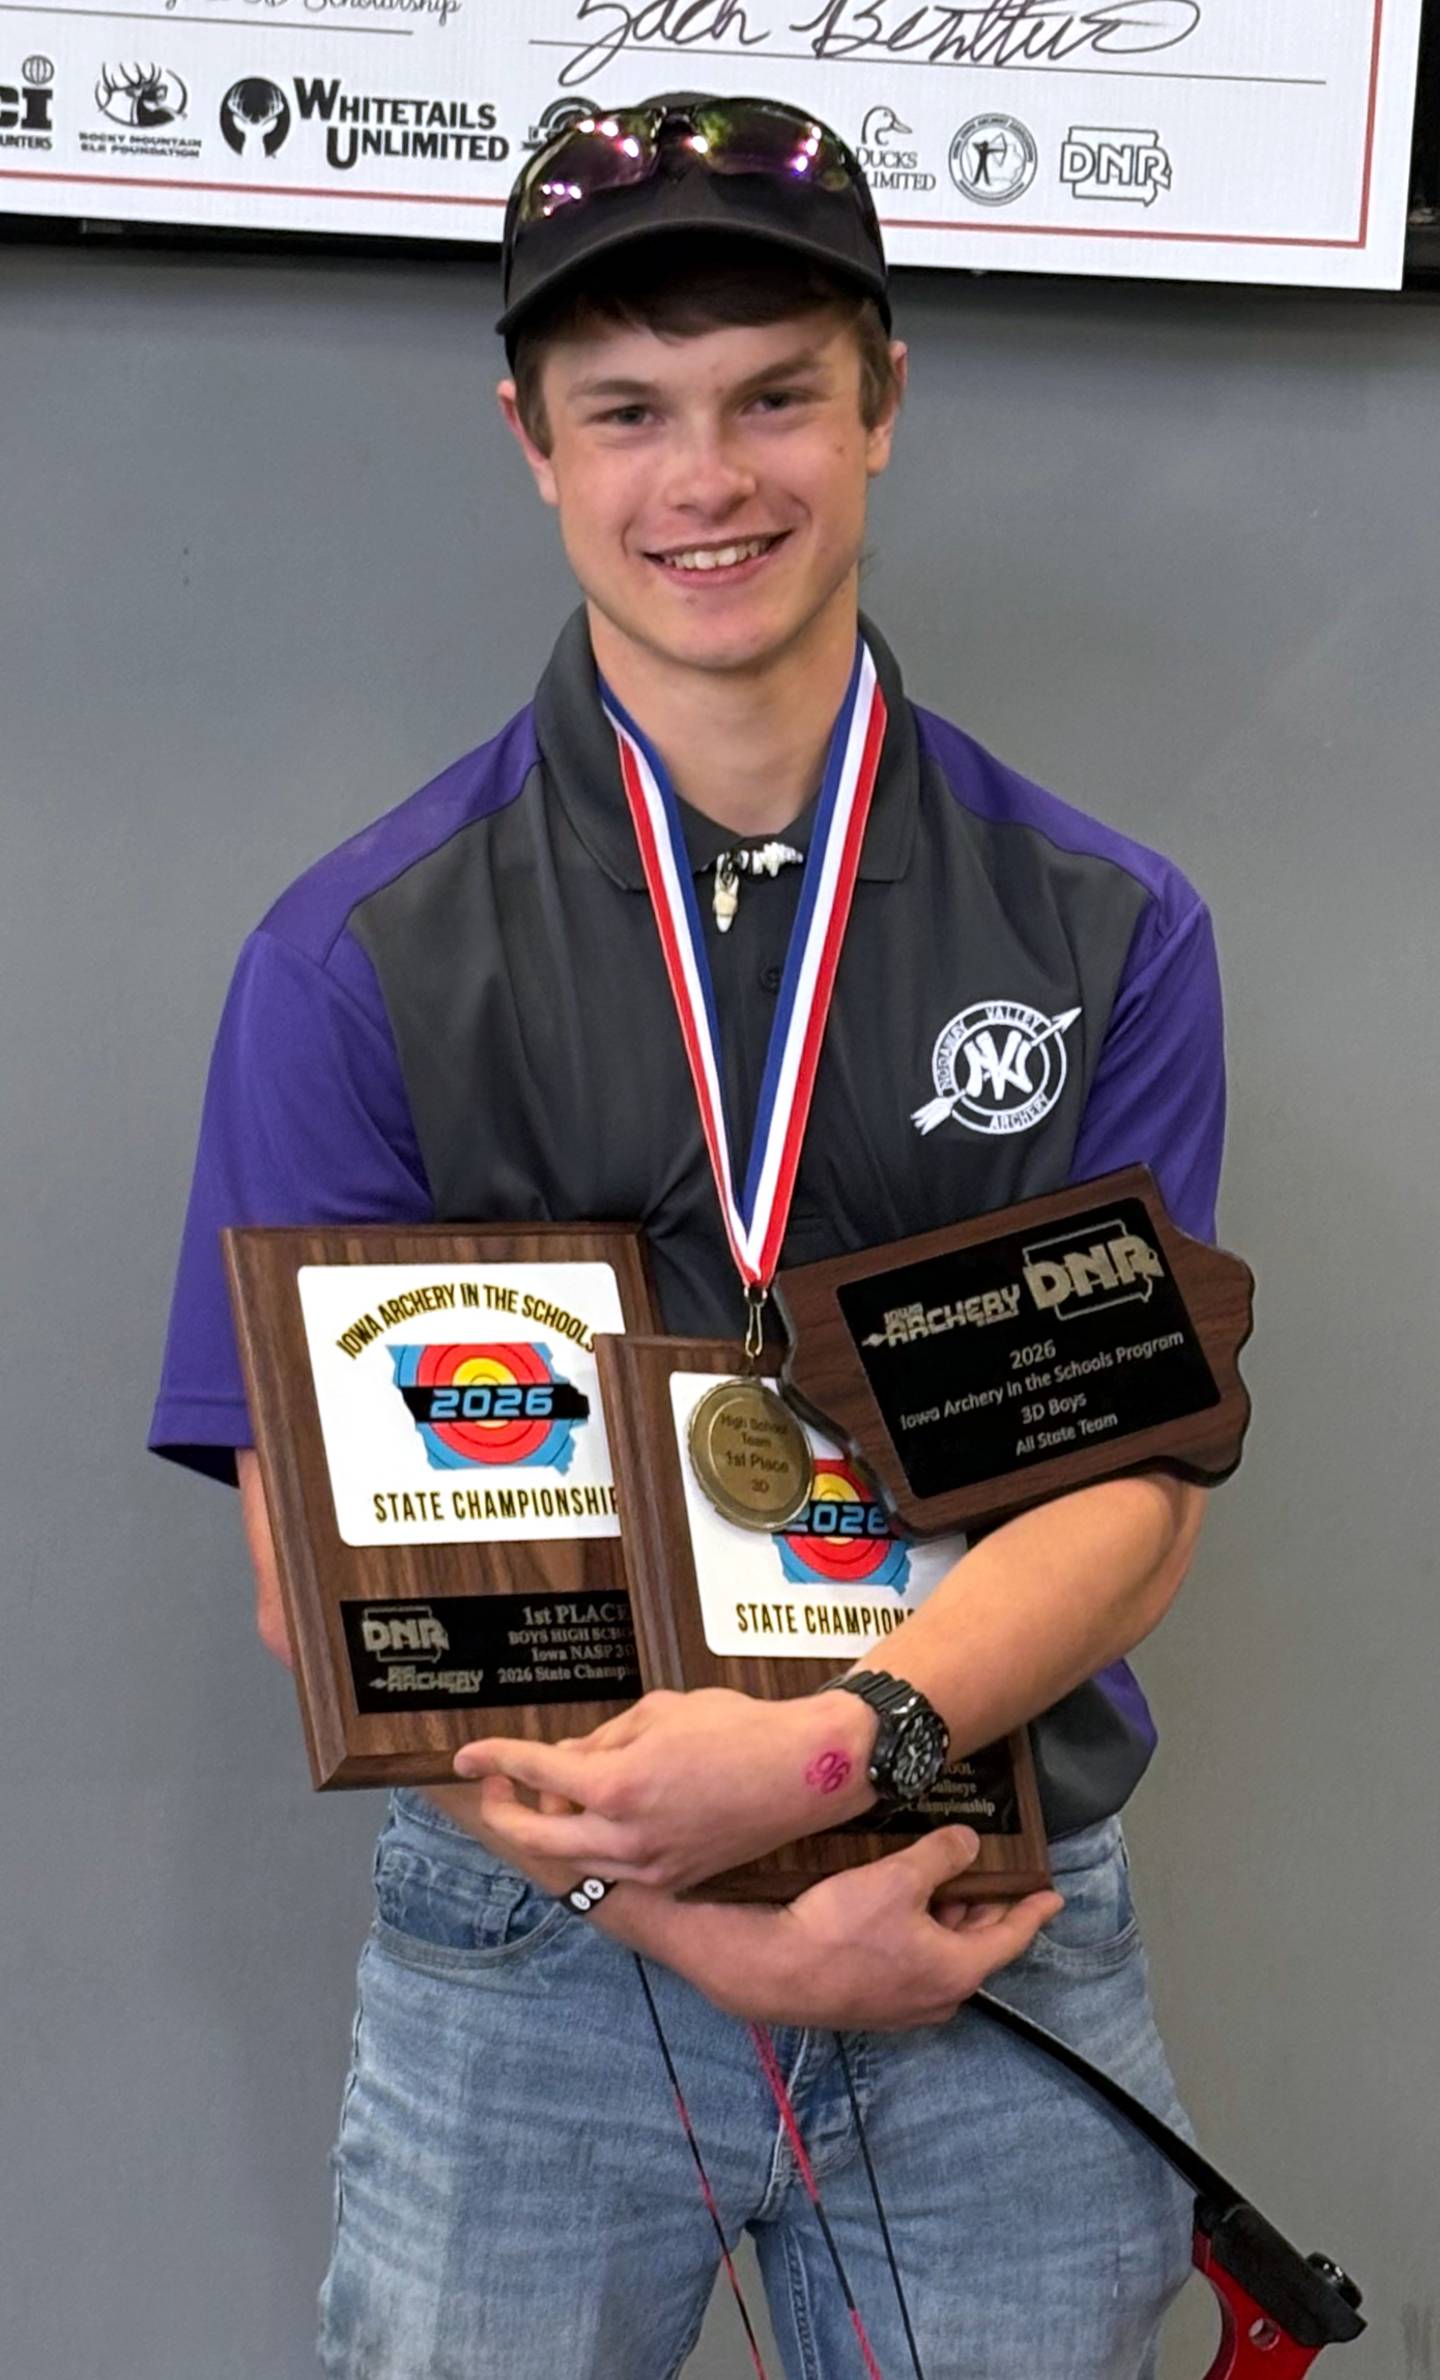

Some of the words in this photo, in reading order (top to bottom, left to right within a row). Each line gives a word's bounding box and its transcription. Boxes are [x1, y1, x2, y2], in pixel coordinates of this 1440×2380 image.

[293, 77, 497, 131] WHITETAILS
[129, 134, 202, 148] MOUNTAIN
[326, 126, 510, 170] UNLIMITED
[1059, 140, 1172, 192] DNR
[884, 1283, 1021, 1348] ARCHERY
[1022, 1234, 1165, 1310] DNR
[335, 1313, 385, 1360] IOWA
[377, 1283, 456, 1329] ARCHERY
[459, 1282, 480, 1308] IN
[483, 1284, 519, 1314] THE
[1009, 1339, 1057, 1370] 2026
[900, 1407, 941, 1431] Iowa
[943, 1386, 1004, 1418] Archery
[1025, 1371, 1051, 1393] the
[1053, 1352, 1114, 1383] Schools
[1116, 1331, 1185, 1364] Program
[429, 1386, 555, 1420] 2026
[1020, 1404, 1046, 1425] 3D
[1048, 1392, 1088, 1417] Boys
[741, 1431, 772, 1448] Team
[1015, 1437, 1036, 1456] All
[1038, 1423, 1077, 1450] State
[1078, 1412, 1119, 1437] Team
[725, 1450, 746, 1467] 1st
[750, 1453, 790, 1473] Place
[373, 1491, 445, 1523] STATE
[521, 1604, 553, 1626] 1st
[736, 1603, 799, 1634] STATE
[804, 1604, 916, 1636] CHAMPION
[361, 1618, 450, 1652] DNR
[507, 1628, 549, 1645] BOYS
[550, 1627, 590, 1643] HIGH
[530, 1646, 568, 1662] Iowa
[496, 1666, 534, 1685] 2026
[534, 1665, 572, 1682] State
